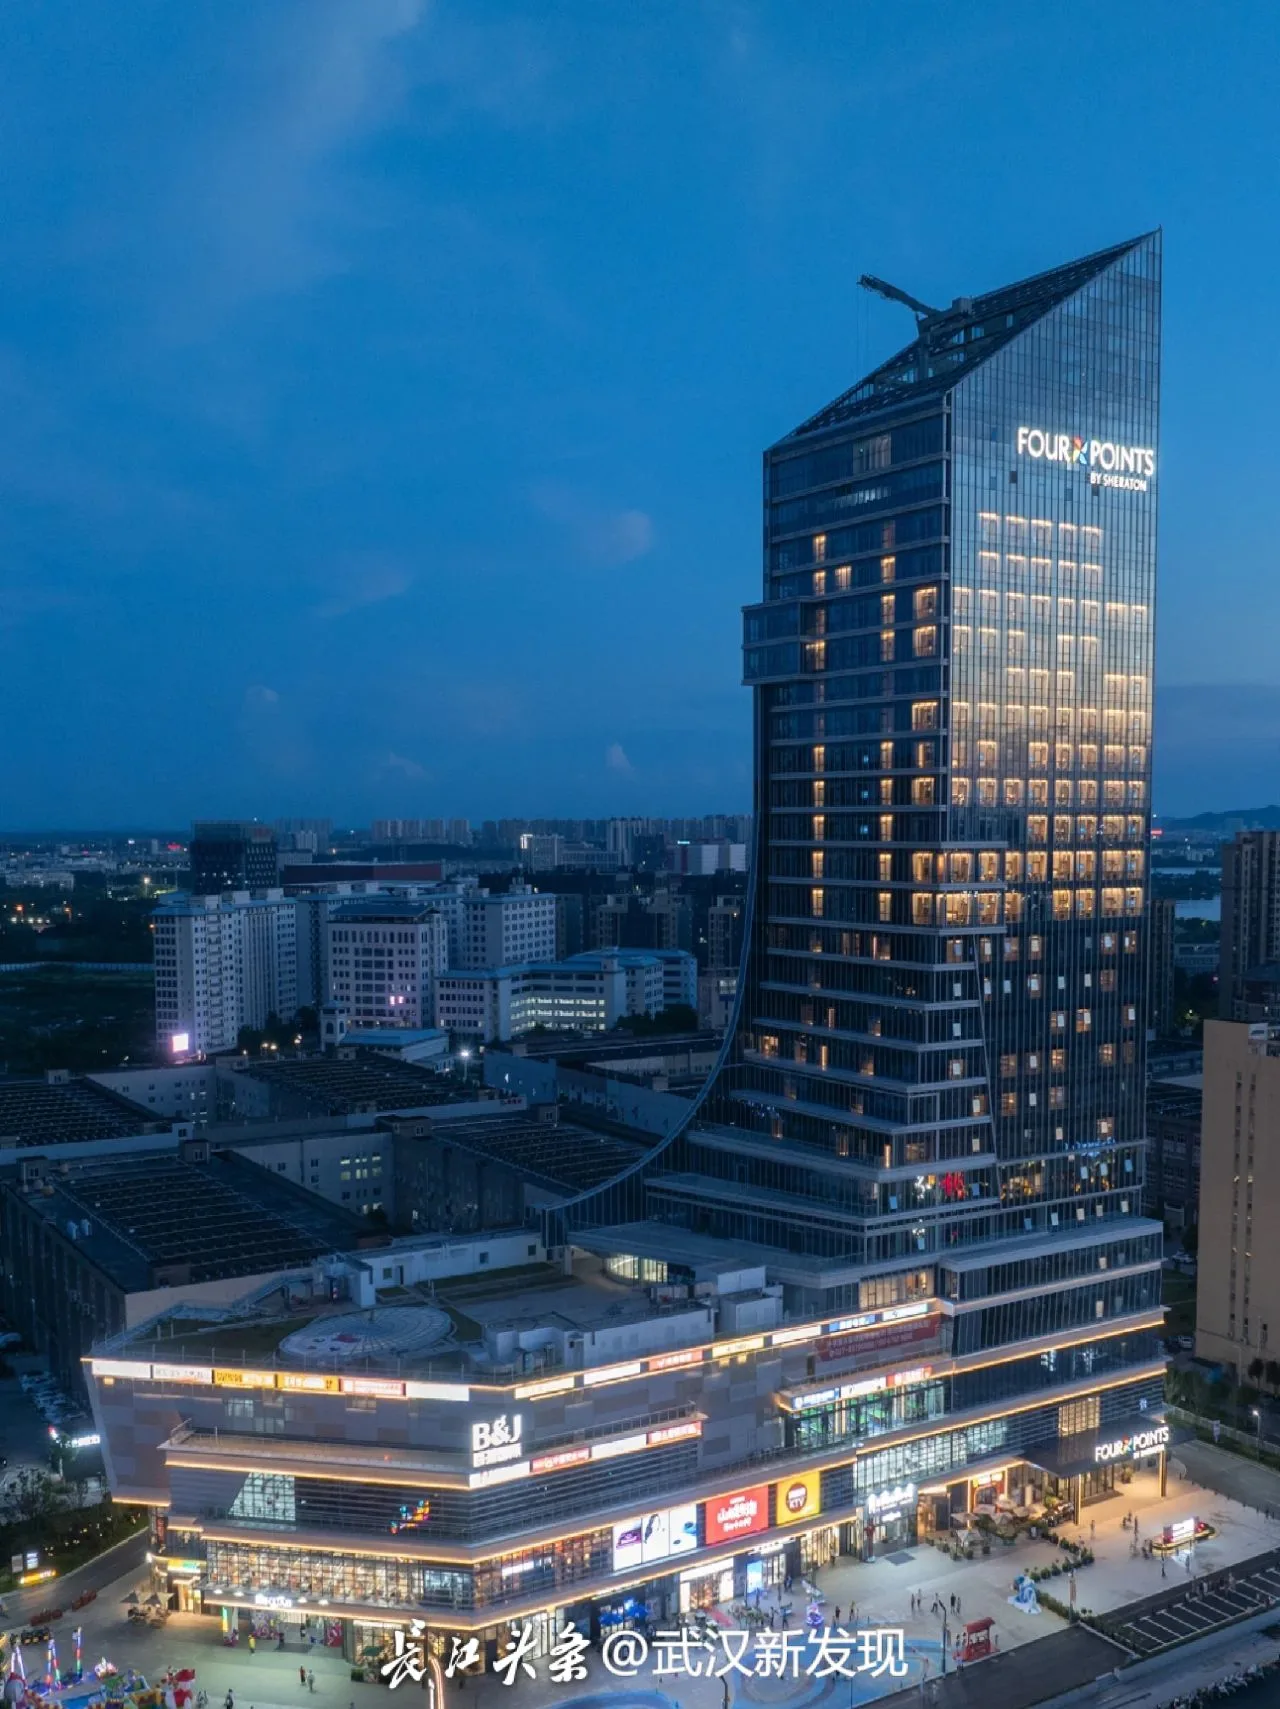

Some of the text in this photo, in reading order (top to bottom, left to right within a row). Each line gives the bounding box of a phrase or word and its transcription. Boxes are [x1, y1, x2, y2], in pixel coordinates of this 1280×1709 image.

[1018, 426, 1154, 477] FOUR POINTS
[1090, 472, 1147, 492] BY SHERATON
[472, 1414, 522, 1451] B&J
[1095, 1439, 1125, 1462] FOUR
[1133, 1427, 1169, 1450] POINTS
